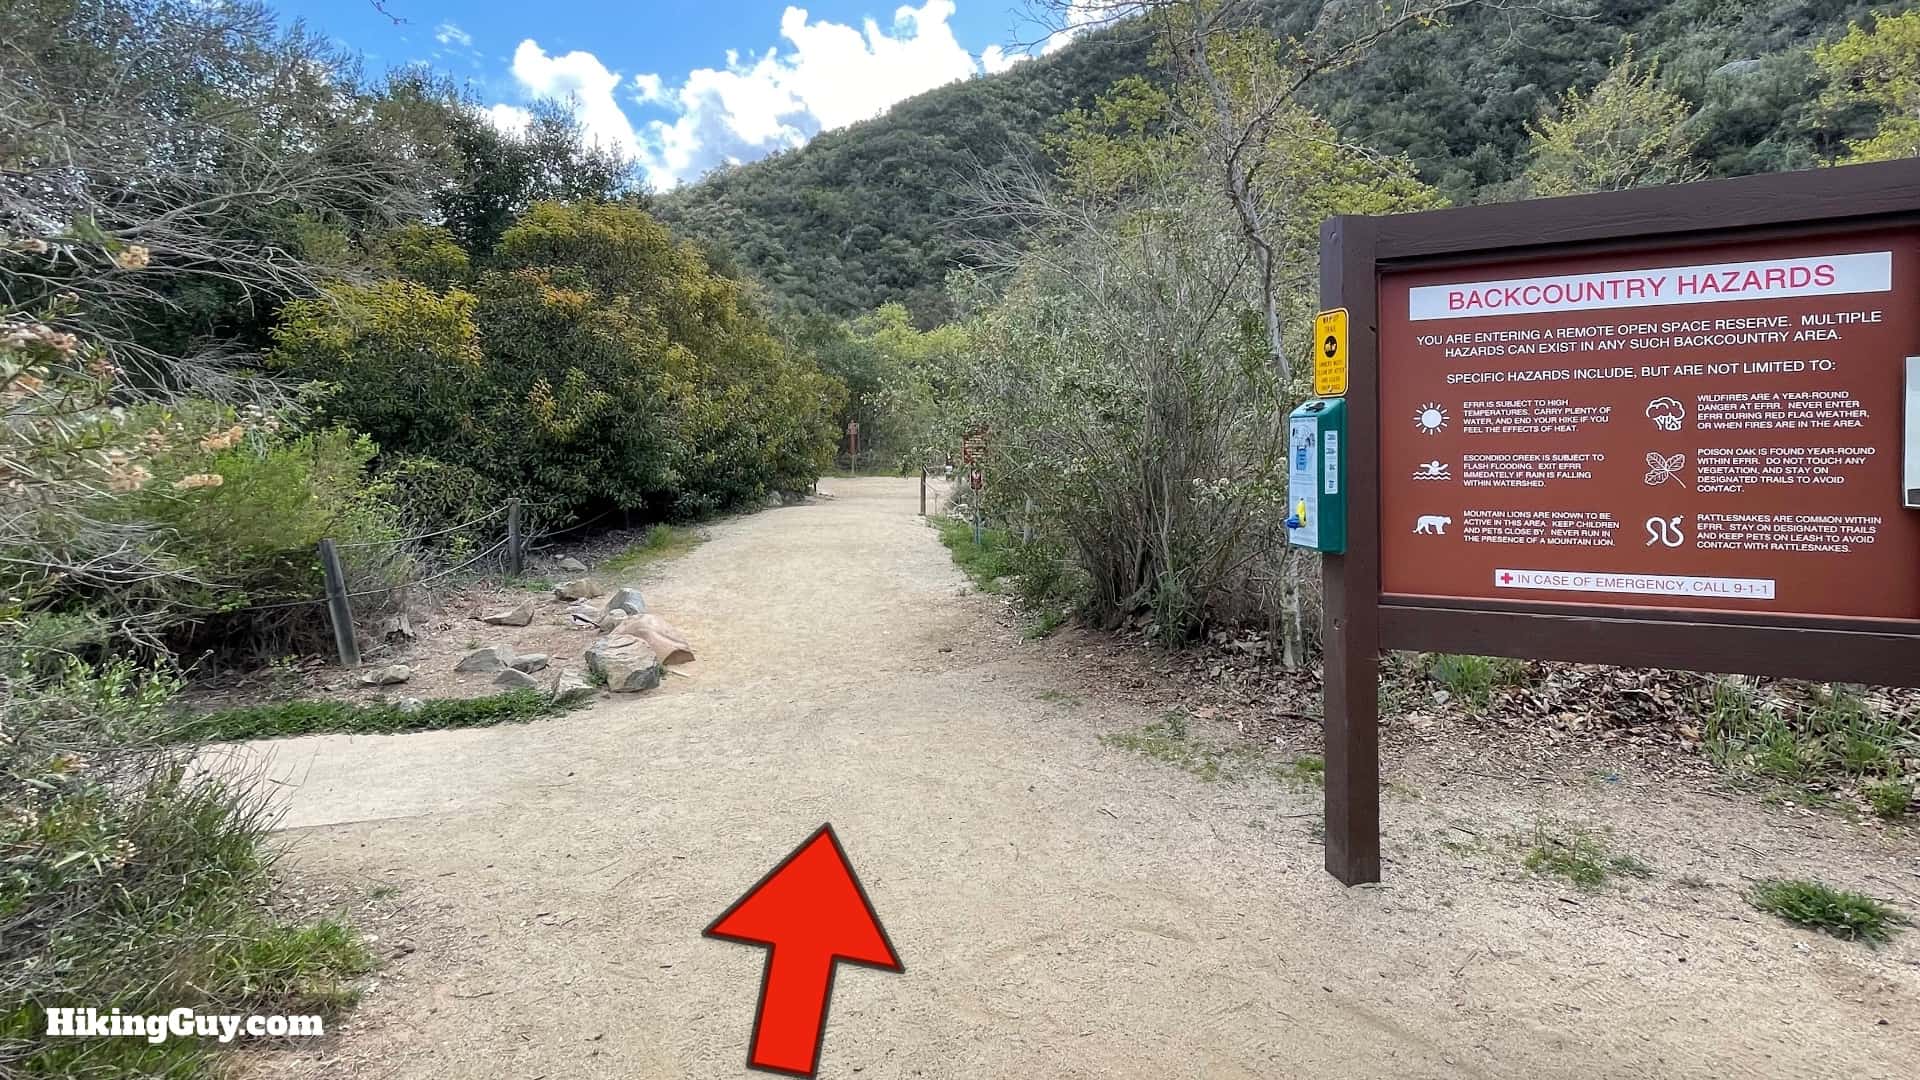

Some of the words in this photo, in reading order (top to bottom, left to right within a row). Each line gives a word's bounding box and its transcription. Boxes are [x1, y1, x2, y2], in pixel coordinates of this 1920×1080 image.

[1448, 276, 1668, 311] BACKCOUNTRY
[1677, 264, 1836, 296] HAZARDS
[1417, 334, 1444, 346] YOU
[1445, 333, 1472, 345] ARE
[1474, 329, 1541, 343] ENTERING
[1543, 328, 1554, 340] A
[1556, 325, 1615, 339] REMOTE
[1617, 323, 1658, 336] OPEN
[1661, 320, 1711, 334] SPACE
[1714, 316, 1792, 331] RESERVE.
[1801, 311, 1882, 327] MULTIPLE
[1445, 344, 1505, 358] HAZARDS
[1507, 343, 1536, 356] CAN
[1538, 341, 1576, 354] EXIST
[1579, 340, 1594, 352] IN
[1596, 339, 1626, 352] ANY
[1630, 337, 1670, 350] SUCH
[1674, 331, 1789, 348] BACKCOUNTRY
[1793, 329, 1842, 343] AREA.
[1447, 371, 1505, 384] SPECIFIC
[1507, 369, 1570, 382] HAZARDS
[1573, 367, 1637, 380] INCLUDE,
[1641, 365, 1669, 378] BUT
[1673, 364, 1704, 377] ARE
[1707, 363, 1740, 376] NOT
[1744, 361, 1805, 375] LIMITED
[1809, 359, 1837, 373] TO:
[1697, 393, 1749, 402] WILDFIRES
[1750, 393, 1768, 401] ARE
[1782, 391, 1849, 400] YEAR-ROUND
[1463, 401, 1485, 409] EFRR
[1495, 400, 1533, 408] SUBJECT
[1547, 399, 1568, 407] HIGH
[1697, 403, 1737, 411] DANGER
[1739, 402, 1753, 410] AT
[1754, 402, 1783, 410] EFRR.
[1788, 401, 1823, 409] NEVER
[1825, 400, 1860, 409] ENTER
[1463, 408, 1530, 417] TEMPERATURES.
[1534, 407, 1563, 416] CARRY
[1564, 407, 1597, 415] PLENTY
[1598, 406, 1612, 414] OF
[1697, 412, 1723, 420] EFRR
[1725, 412, 1762, 420] DURING
[1764, 411, 1785, 419] RED
[1787, 411, 1814, 419] FLAG
[1815, 410, 1870, 419] WEATHER,
[1463, 417, 1494, 425] WATER,
[1495, 417, 1513, 425] AND
[1514, 416, 1531, 424] END
[1532, 416, 1557, 424] YOUR
[1558, 416, 1579, 424] HIKE
[1589, 415, 1609, 423] YOU
[1697, 422, 1713, 430] OR
[1713, 421, 1743, 429] WHEN
[1744, 421, 1773, 429] FIRES
[1774, 421, 1796, 429] ARE
[1809, 420, 1830, 428] THE
[1833, 420, 1864, 428] AREA.
[1502, 425, 1539, 433] EFFECTS
[1697, 448, 1734, 456] POISON
[1735, 448, 1756, 456] OAK
[1758, 448, 1768, 456] IS
[1769, 448, 1805, 456] FOUND
[1806, 447, 1876, 455] YEAR-ROUND
[1463, 454, 1511, 462] ESCONDIDO
[1512, 454, 1540, 462] CREEK
[1542, 454, 1551, 462] IS
[1551, 454, 1590, 462] SUBJECT
[1697, 457, 1730, 465] WITHIN
[1732, 457, 1760, 465] EFRR.
[1766, 457, 1780, 465] DO
[1782, 457, 1804, 465] NOT
[1806, 457, 1842, 465] TOUCH
[1844, 457, 1866, 465] ANY
[1516, 471, 1524, 479] IF
[1525, 471, 1545, 479] RAIN
[1547, 471, 1555, 479] IS
[1556, 471, 1592, 479] FALLING
[1784, 467, 1811, 475] STAY
[1813, 467, 1829, 475] ON
[1463, 479, 1491, 487] WITHIN
[1493, 480, 1546, 488] WATERSHED.
[1759, 476, 1794, 484] TRAILS
[1796, 476, 1810, 484] TO
[1811, 476, 1844, 484] AVOID
[1697, 485, 1744, 493] CONTACT.
[1463, 510, 1506, 518] MOUNTAIN
[1532, 511, 1550, 519] ARE
[1551, 511, 1584, 519] KNOWN
[1599, 512, 1612, 520] BE
[1697, 514, 1771, 523] RATTLESNAKES
[1772, 515, 1793, 523] ARE
[1795, 515, 1842, 524] COMMON
[1844, 516, 1881, 524] WITHIN
[1494, 519, 1502, 527] IN
[1551, 520, 1575, 528] KEEP
[1576, 521, 1620, 529] CHILDREN
[1697, 523, 1724, 531] EFRR.
[1729, 524, 1755, 532] STAY
[1757, 524, 1771, 532] ON
[1773, 524, 1838, 533] DESIGNATED
[1839, 525, 1876, 534] TRAILS
[1463, 527, 1481, 535] AND
[1504, 528, 1533, 536] CLOSE
[1551, 529, 1580, 537] NEVER
[1581, 529, 1600, 537] RUN
[1481, 536, 1525, 544] PRESENCE
[1539, 537, 1547, 545] A
[1547, 537, 1592, 546] MOUNTAIN
[1593, 538, 1615, 546] LION.
[1696, 532, 1717, 540] AND
[1718, 533, 1744, 541] KEEP
[1746, 533, 1771, 541] PETS
[1773, 534, 1788, 542] ON
[1790, 534, 1824, 543] LEASH
[1825, 535, 1840, 543] TO
[1842, 535, 1874, 544] AVOID
[1696, 541, 1742, 550] CONTACT
[1743, 542, 1769, 551] WITH
[1770, 542, 1852, 553] RATTLESNAKES.
[1517, 574, 1532, 585] IN
[1534, 574, 1569, 586] CASE
[1574, 576, 1591, 587] OF
[1595, 577, 1689, 591] EMERGENCY,
[1693, 581, 1729, 593] CALL
[1733, 582, 1769, 594] 9-1-1
